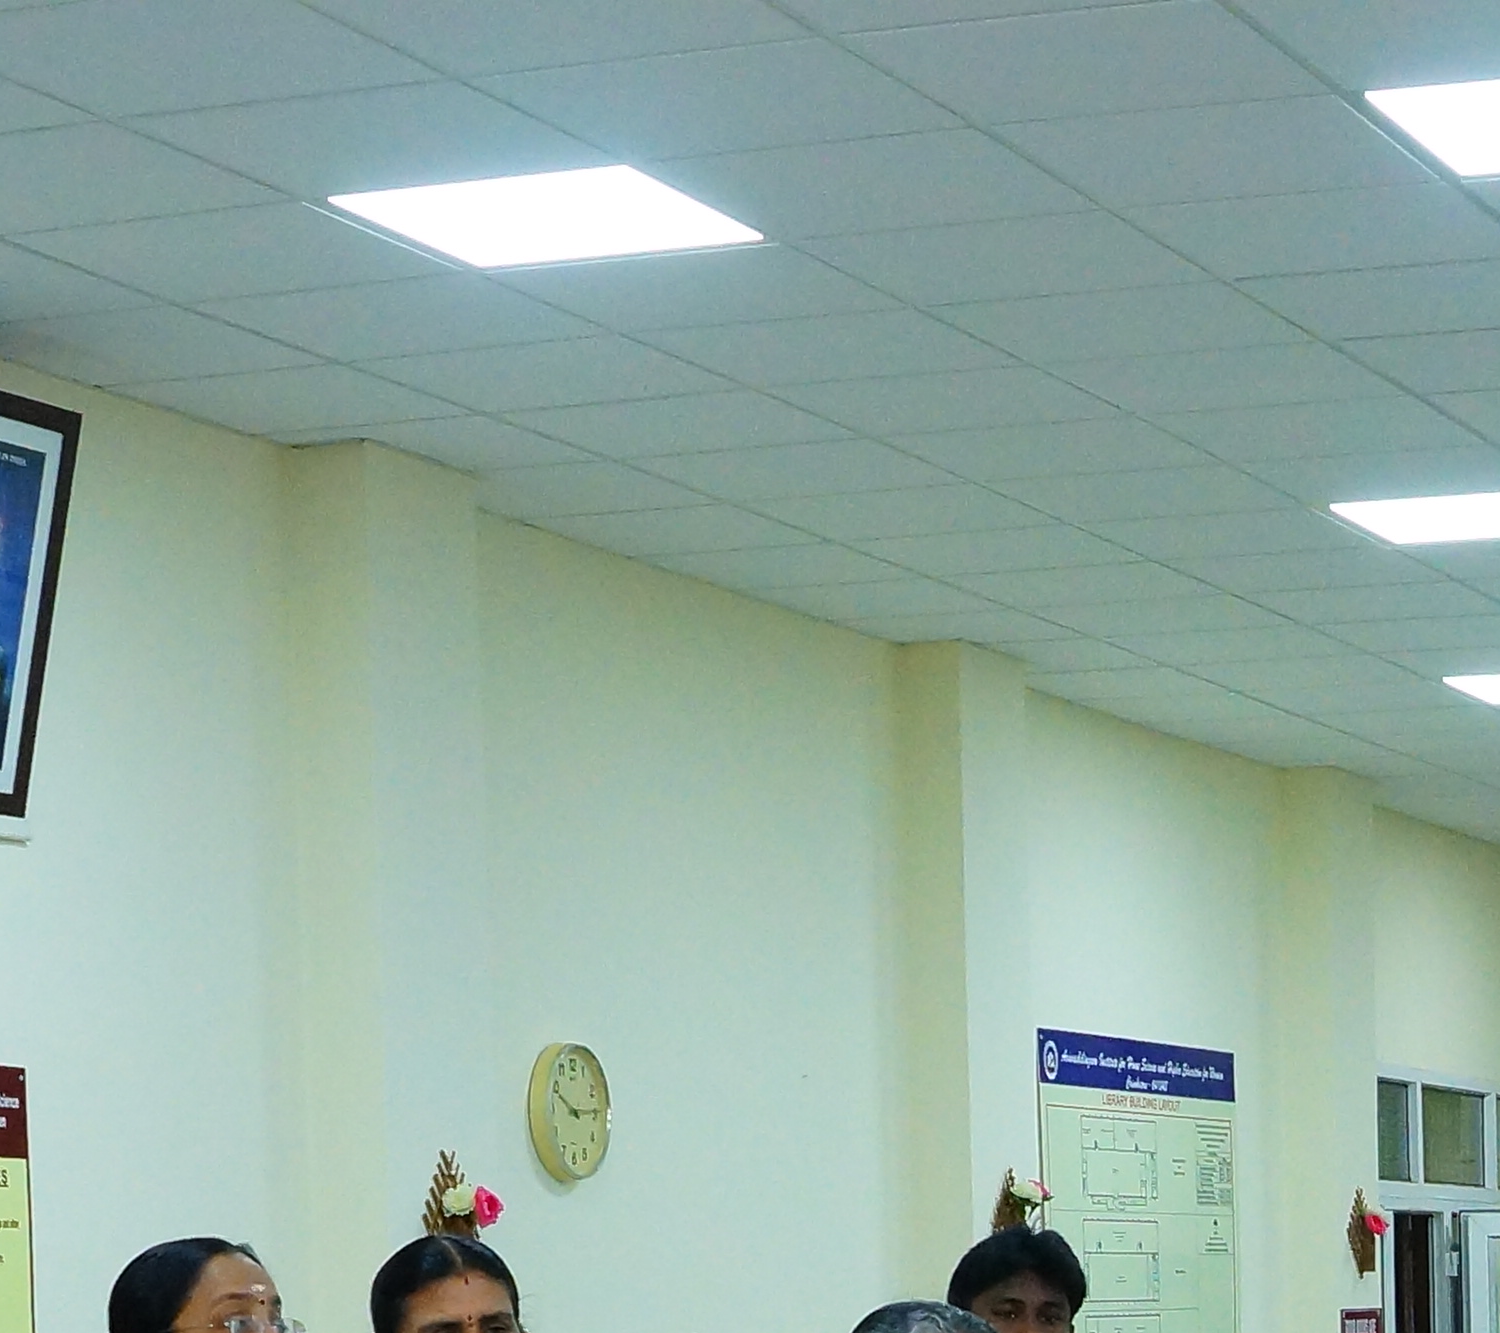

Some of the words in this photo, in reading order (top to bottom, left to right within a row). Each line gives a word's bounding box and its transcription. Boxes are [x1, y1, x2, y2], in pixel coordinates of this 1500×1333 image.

[1101, 1093, 1128, 1108] LIBRARY
[1129, 1095, 1158, 1111] BUILDING
[1158, 1098, 1181, 1112] LAYOUT
